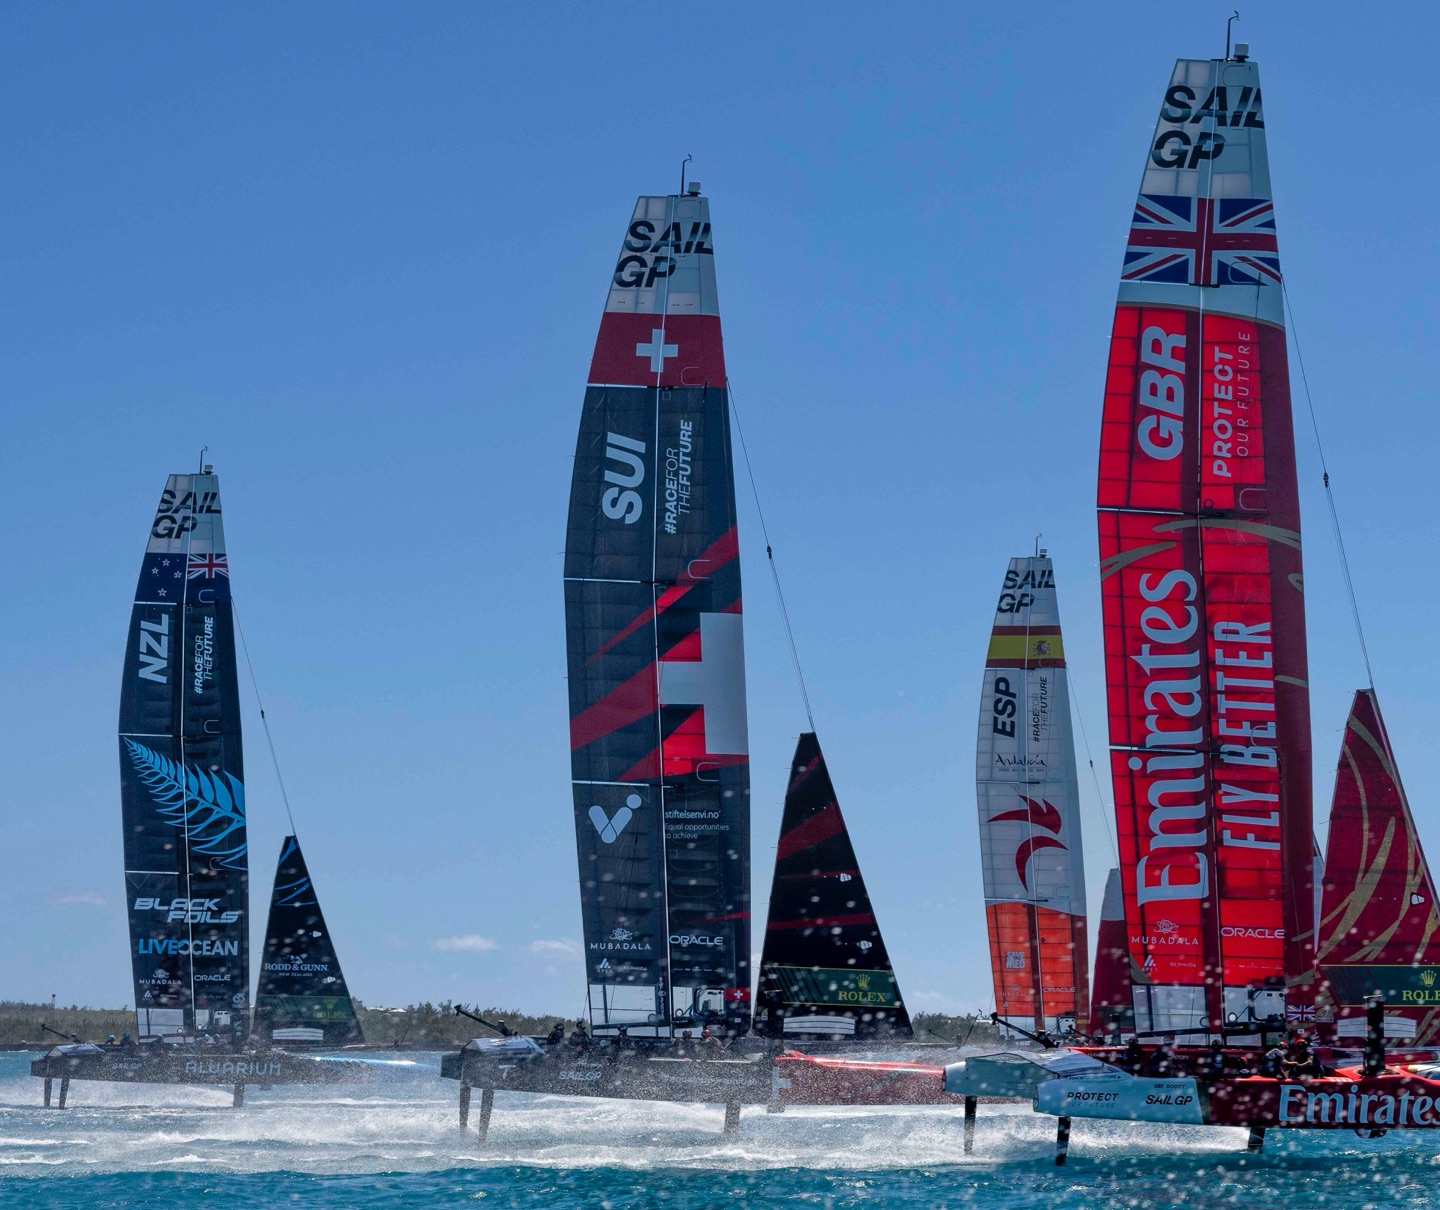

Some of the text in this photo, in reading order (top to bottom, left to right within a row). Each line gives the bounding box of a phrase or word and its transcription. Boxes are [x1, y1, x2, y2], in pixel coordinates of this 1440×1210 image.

[1160, 85, 1265, 128] SAIL
[1151, 130, 1225, 169] GP
[624, 220, 714, 255] SAIL
[613, 255, 677, 288] GP
[1138, 325, 1187, 460] GBR
[1236, 331, 1250, 457] OUR FUTURE
[1213, 346, 1235, 477] PROTECT
[602, 431, 646, 524] SUI
[678, 419, 693, 515] THEFUTURE
[157, 489, 222, 515] SAIL
[664, 447, 678, 534] #RACEFOR
[151, 515, 198, 540] GP
[1003, 569, 1056, 589] SAIL
[997, 592, 1034, 614] GP
[139, 614, 169, 684] NZL
[193, 635, 204, 694] #RACEFOR
[203, 616, 213, 681] THEFUTURE
[993, 676, 1017, 738] ESP
[1128, 569, 1209, 906] Emirates
[1214, 620, 1281, 851] FLY BETTER
[664, 823, 730, 831] Equal opportunities
[134, 898, 221, 910] BLACK
[167, 911, 239, 923] FOILS
[590, 942, 651, 950] MUBADALA
[669, 935, 723, 945] ORACLE
[1131, 936, 1199, 945] MUBADALA
[1221, 927, 1285, 939] ORACLE
[838, 990, 886, 1002] ROLEX
[1067, 1092, 1119, 1102] PROTECT
